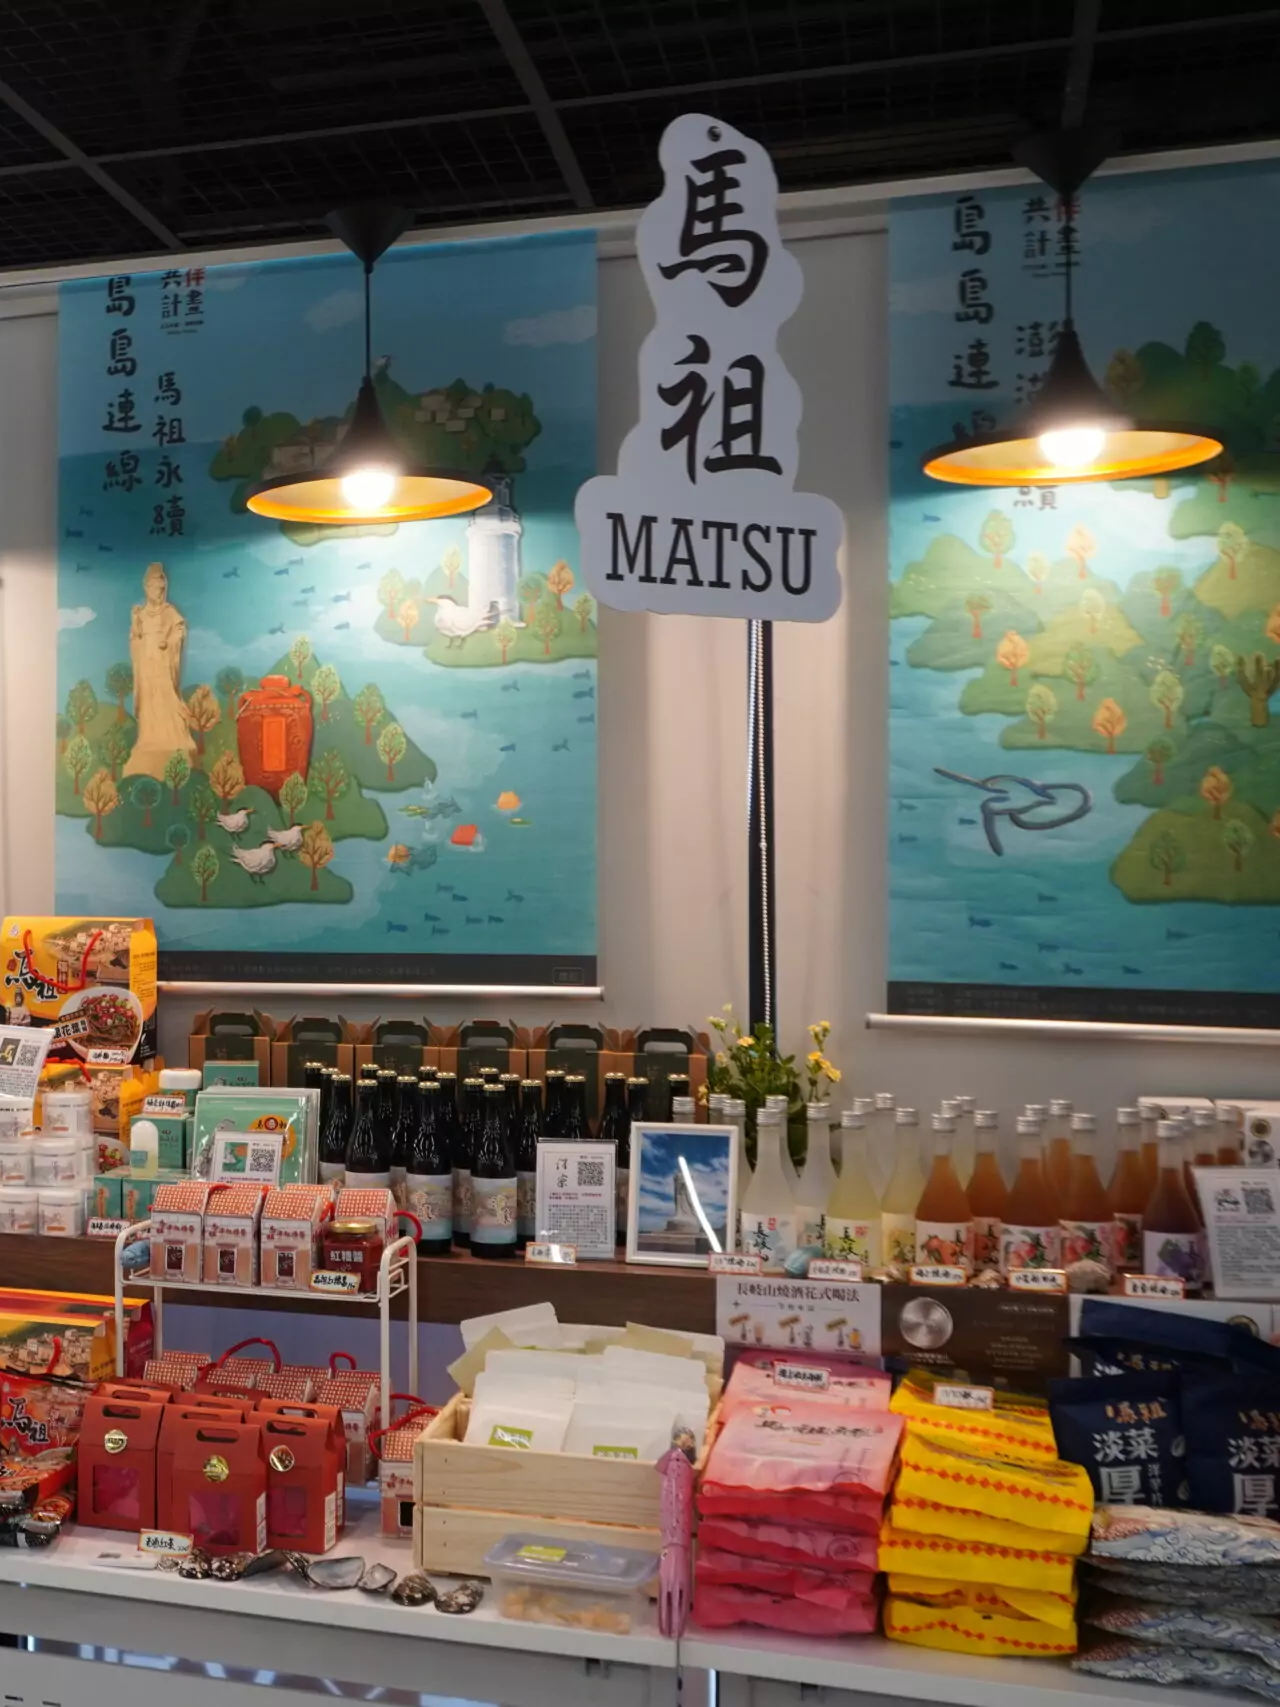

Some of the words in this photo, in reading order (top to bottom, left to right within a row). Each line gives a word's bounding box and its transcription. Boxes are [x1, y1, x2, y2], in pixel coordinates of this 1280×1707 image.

[657, 148, 783, 485] 馬祖
[102, 275, 143, 493] 島島連線
[149, 371, 186, 538] 馬祖永續
[606, 511, 817, 595] MATSU
[1091, 1426, 1159, 1463] 淡菜
[1097, 1464, 1146, 1505] 厚
